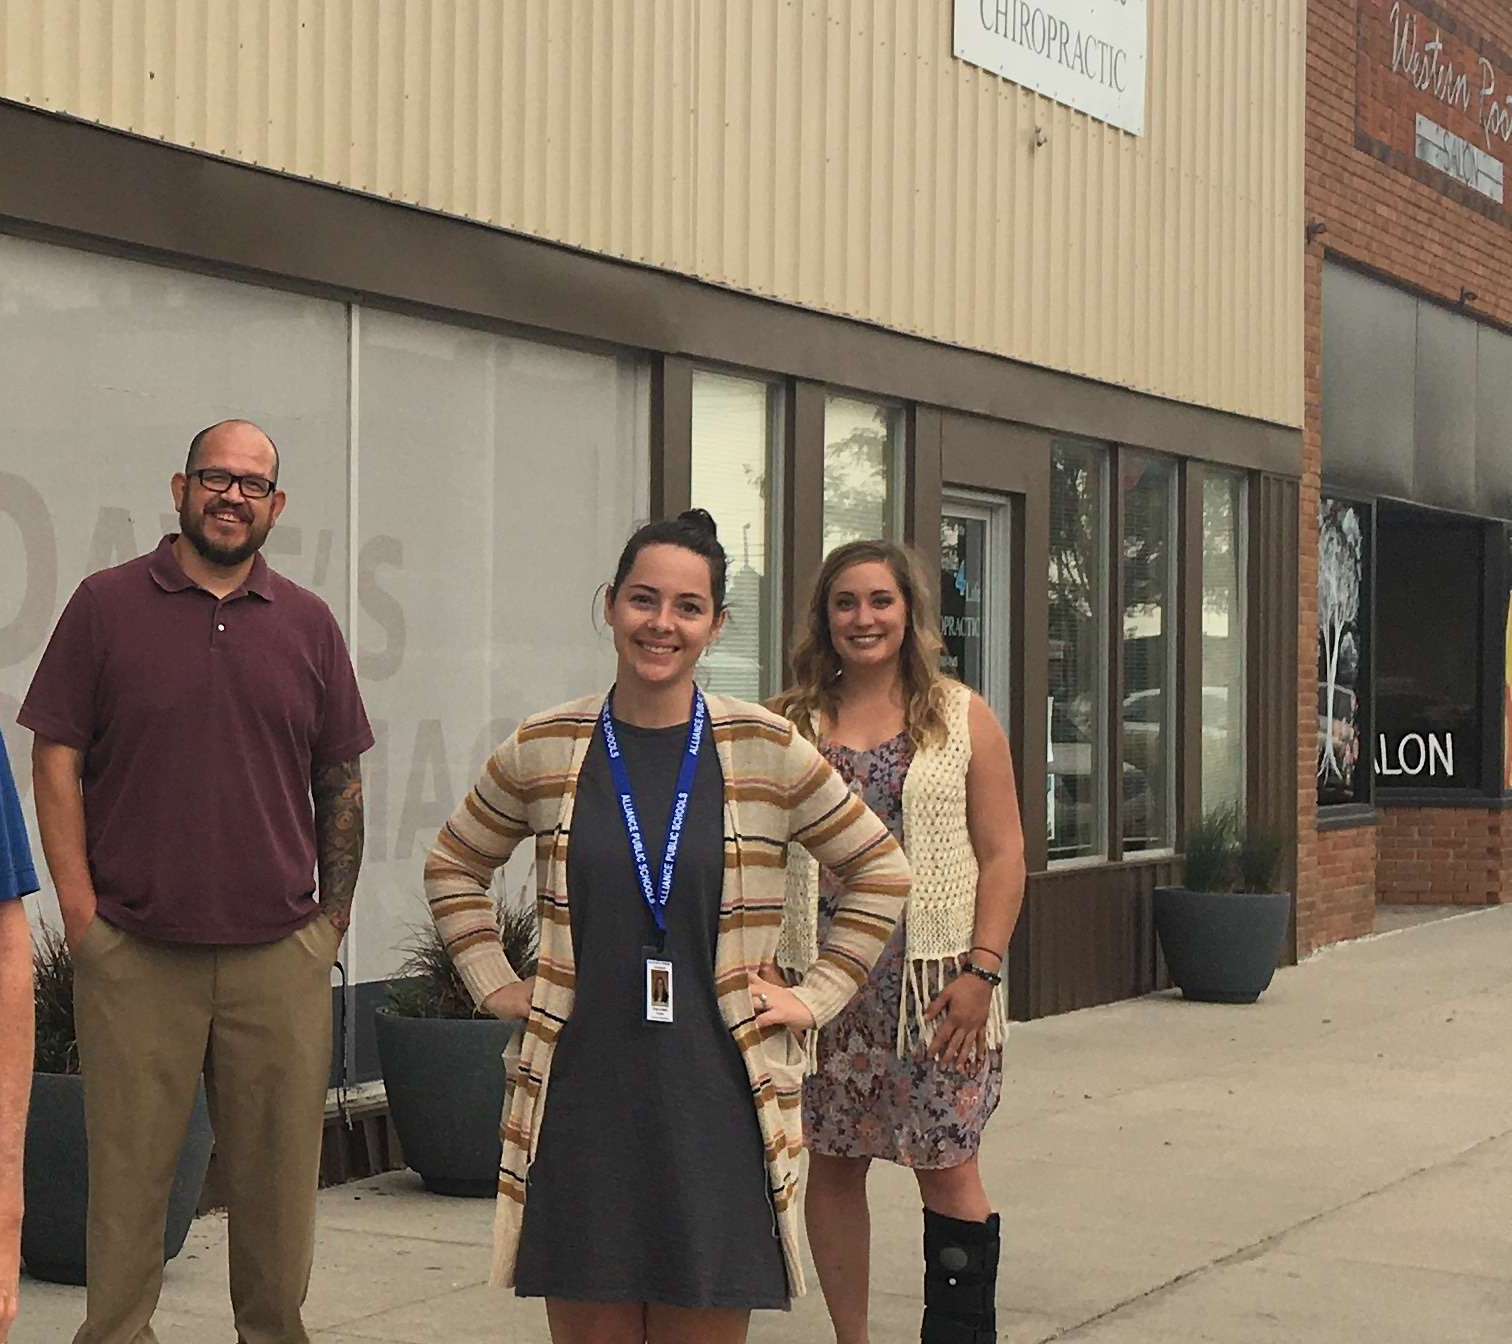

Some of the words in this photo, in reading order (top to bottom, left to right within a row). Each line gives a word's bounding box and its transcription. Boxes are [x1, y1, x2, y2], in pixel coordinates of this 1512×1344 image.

[1389, 1, 1471, 112] Western
[621, 794, 640, 832] ALLIANCE
[671, 792, 688, 831] SCHOOLS
[631, 832, 647, 863] PUBLIC
[665, 831, 680, 863] PUBLIC
[638, 863, 656, 905] SCHOOLS
[659, 862, 674, 905] ALLIANCE
